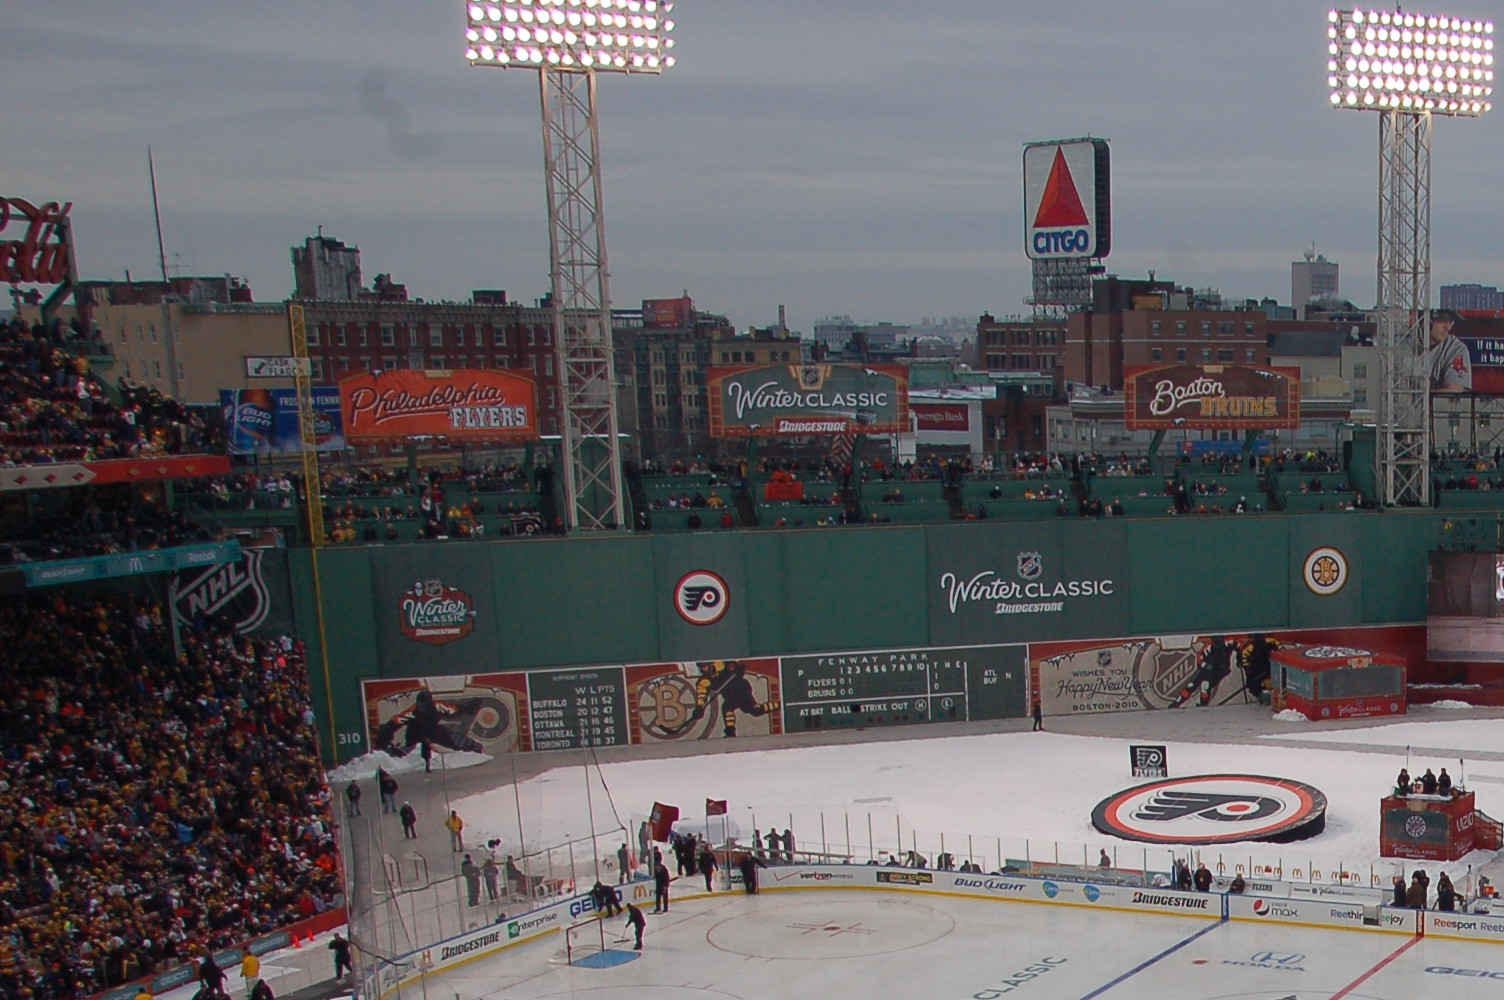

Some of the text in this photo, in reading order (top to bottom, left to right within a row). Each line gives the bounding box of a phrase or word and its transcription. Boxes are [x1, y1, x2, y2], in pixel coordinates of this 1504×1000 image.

[1034, 230, 1089, 253] CITGO
[352, 382, 505, 427] Philadelphia
[728, 381, 888, 420] Winter CLASSIC
[1199, 396, 1279, 417] BRUINS
[242, 408, 271, 420] BUD
[452, 406, 528, 429] FLYERS
[778, 420, 847, 433] BRIDGESTONE
[187, 562, 246, 615] NHL
[941, 570, 1114, 614] Winter CLASSIC
[403, 597, 467, 627] Winter
[995, 601, 1065, 615] BRIDGESTONE
[417, 614, 465, 624] CLASSIC
[818, 653, 928, 667] FENWAY PARK
[984, 669, 996, 677] ATL
[1072, 668, 1127, 677] WISHES YOU
[1160, 662, 1194, 693] NHL
[808, 678, 837, 687] FLYERS
[1055, 677, 1125, 700] Happy New
[575, 685, 615, 695] W L PTS
[808, 689, 837, 698] BRUINS
[532, 699, 567, 709] BUFFALO
[576, 697, 587, 706] 24
[591, 696, 598, 705] 11
[800, 701, 908, 716] AT BAT BALL STRIKE OUT
[534, 705, 613, 719] BOSTON 20 12 47
[534, 719, 565, 729] OTTAWA
[338, 732, 361, 745] 310
[535, 728, 575, 739] MONTREAL
[536, 739, 571, 749] TORONTO
[605, 736, 615, 745] 37
[800, 872, 832, 882] verizon
[954, 878, 1027, 892] BUD LIGHT
[1131, 890, 1208, 909] BRIDGESTONE
[1271, 905, 1299, 918] max
[1434, 917, 1477, 931] Reesport
[441, 931, 501, 961] BRIDGESTONE
[1221, 959, 1305, 972] HONDA
[973, 956, 1068, 1000] CLASSIC
